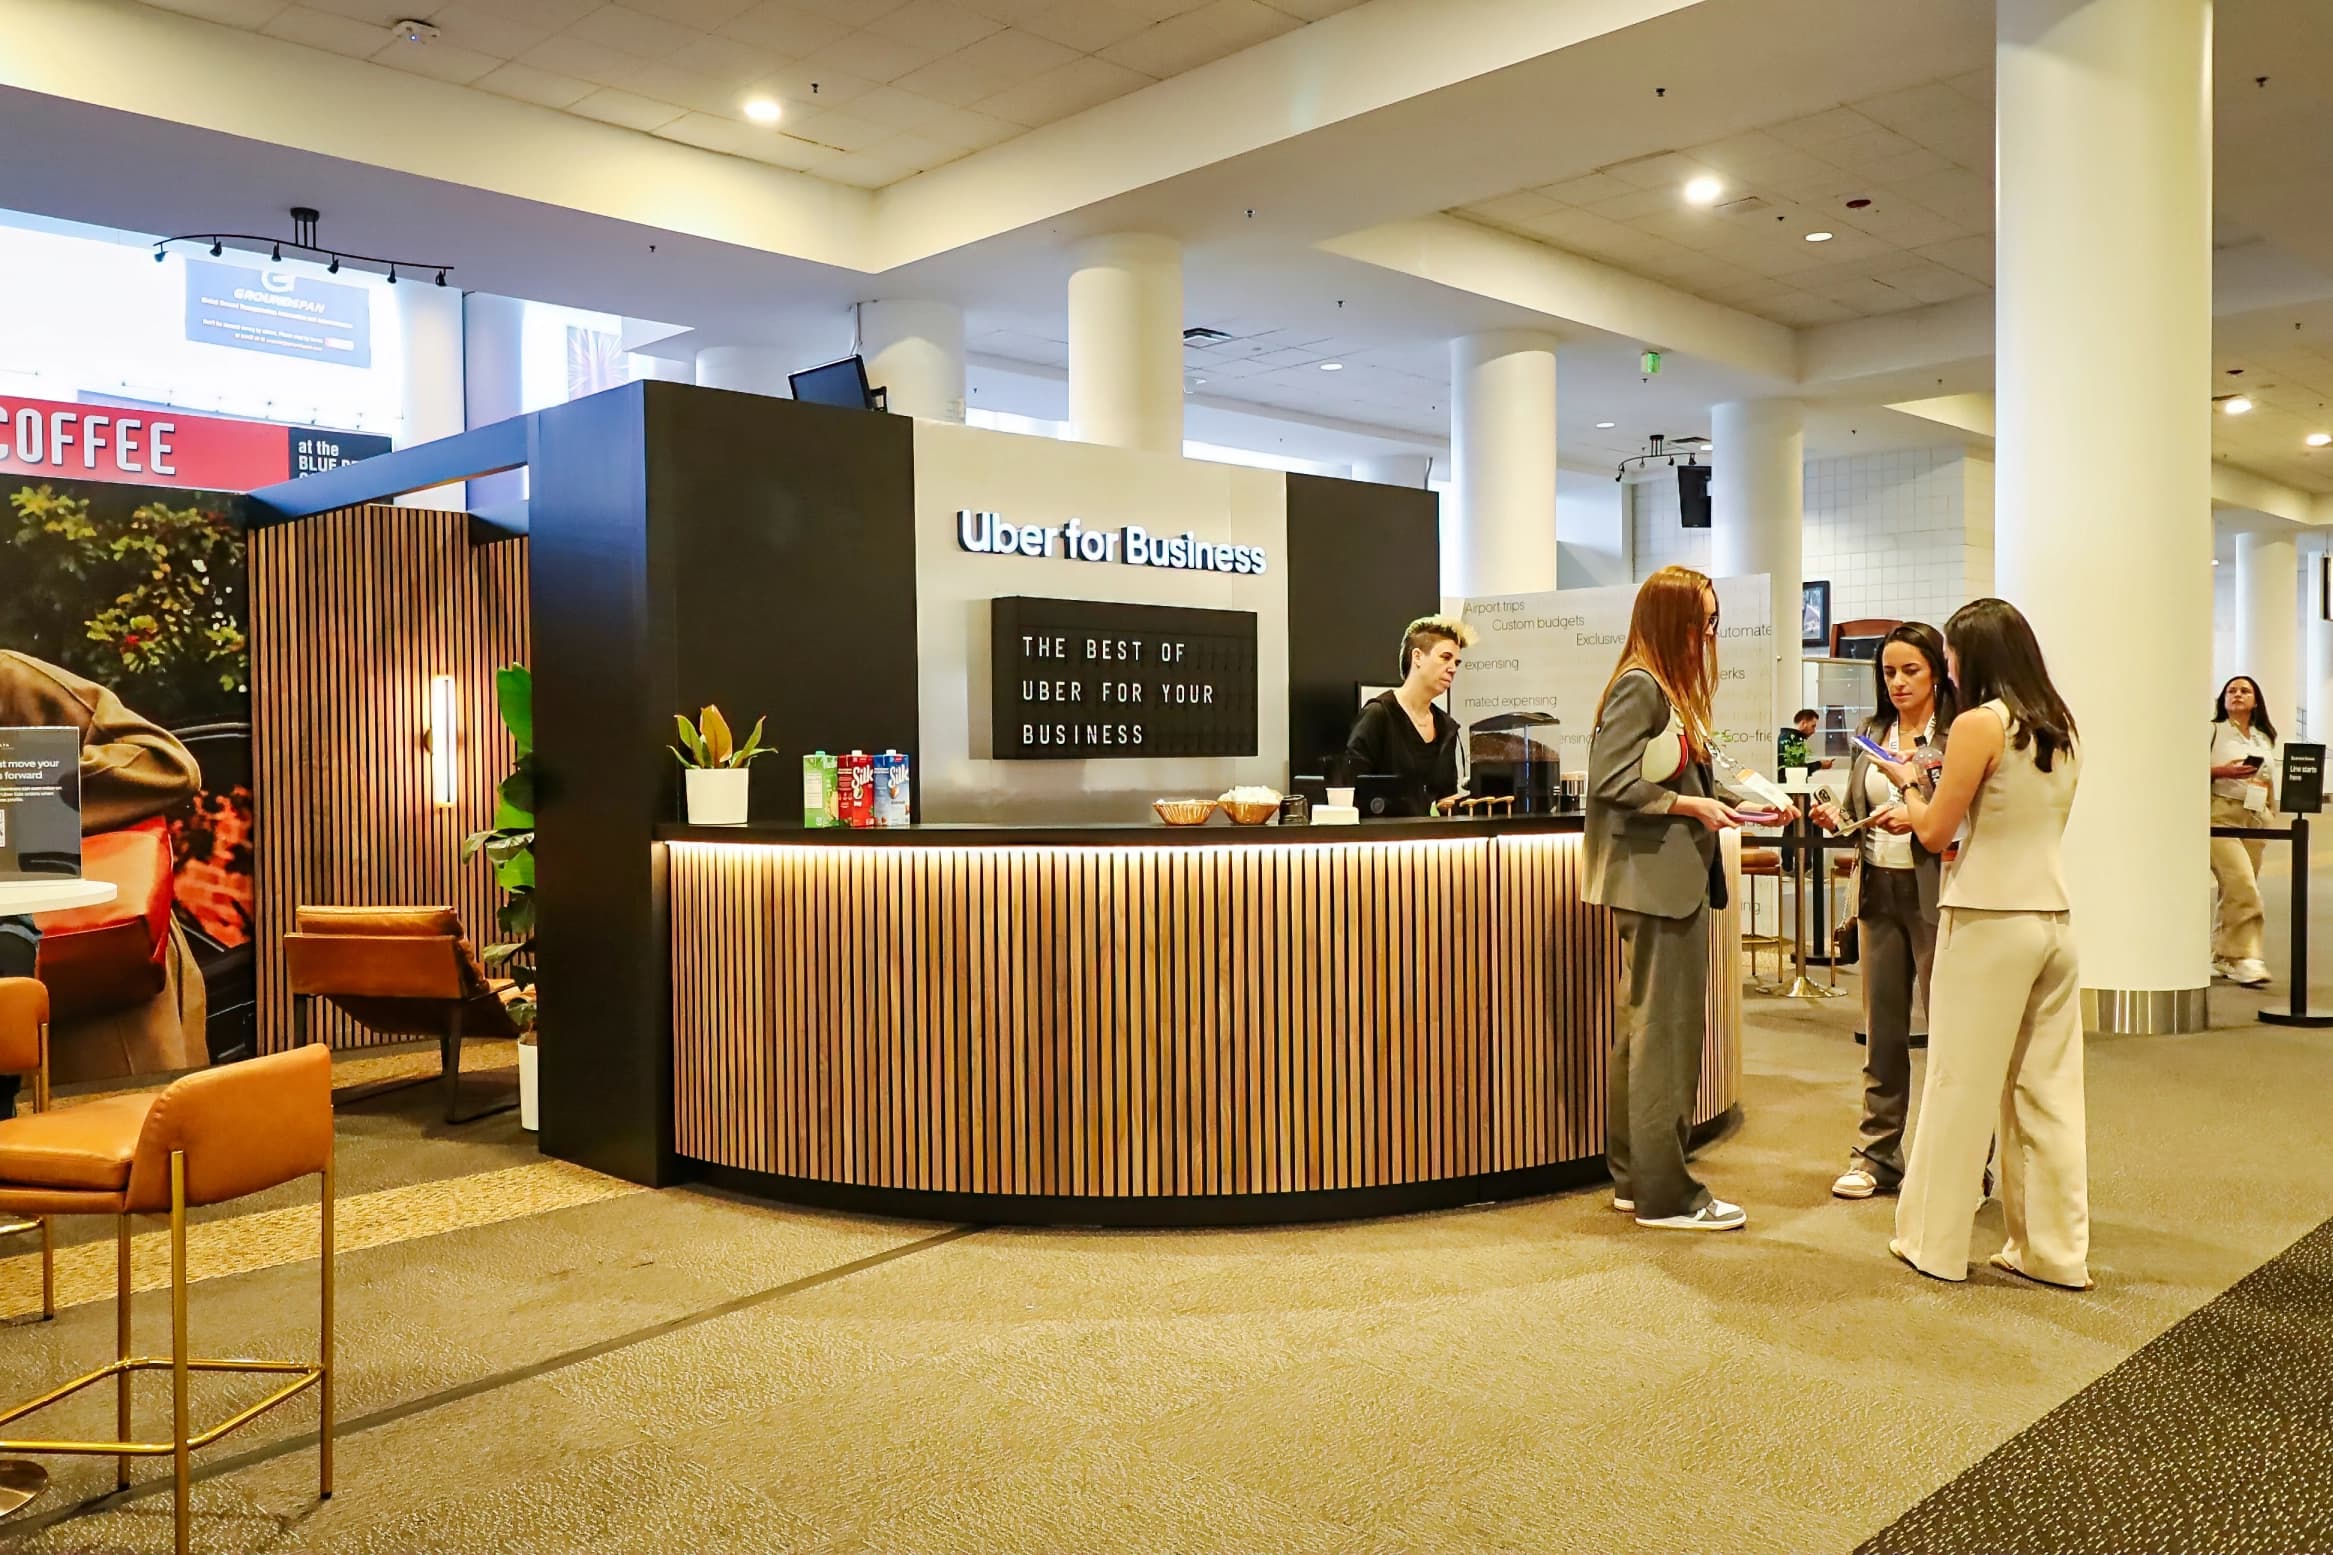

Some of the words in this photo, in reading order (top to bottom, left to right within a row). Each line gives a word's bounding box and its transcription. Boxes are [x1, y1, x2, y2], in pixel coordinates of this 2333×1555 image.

[298, 439, 312, 454] at
[316, 440, 339, 457] the
[958, 509, 1059, 557] Uber
[1064, 517, 1120, 563] for
[1122, 525, 1268, 575] Business
[1464, 601, 1501, 615] Airport
[1503, 600, 1526, 613] trips
[1492, 618, 1535, 632] Custom
[1537, 615, 1585, 632] budgets
[1576, 632, 1626, 647] Exclusive
[1022, 636, 1066, 658] THE
[1086, 639, 1142, 661] BEST
[1161, 642, 1185, 663] OF
[1464, 658, 1519, 672] expensing
[1022, 680, 1082, 702] UBER
[1102, 682, 1143, 703] FOR
[1162, 683, 1214, 704] YOUR
[1502, 695, 1558, 708] expensing
[1022, 723, 1143, 745] BUSINESS
[8, 760, 36, 768] move
[37, 760, 60, 770] your
[4, 770, 43, 780] forward
[851, 764, 874, 789] Silk
[888, 764, 909, 789] Silk
